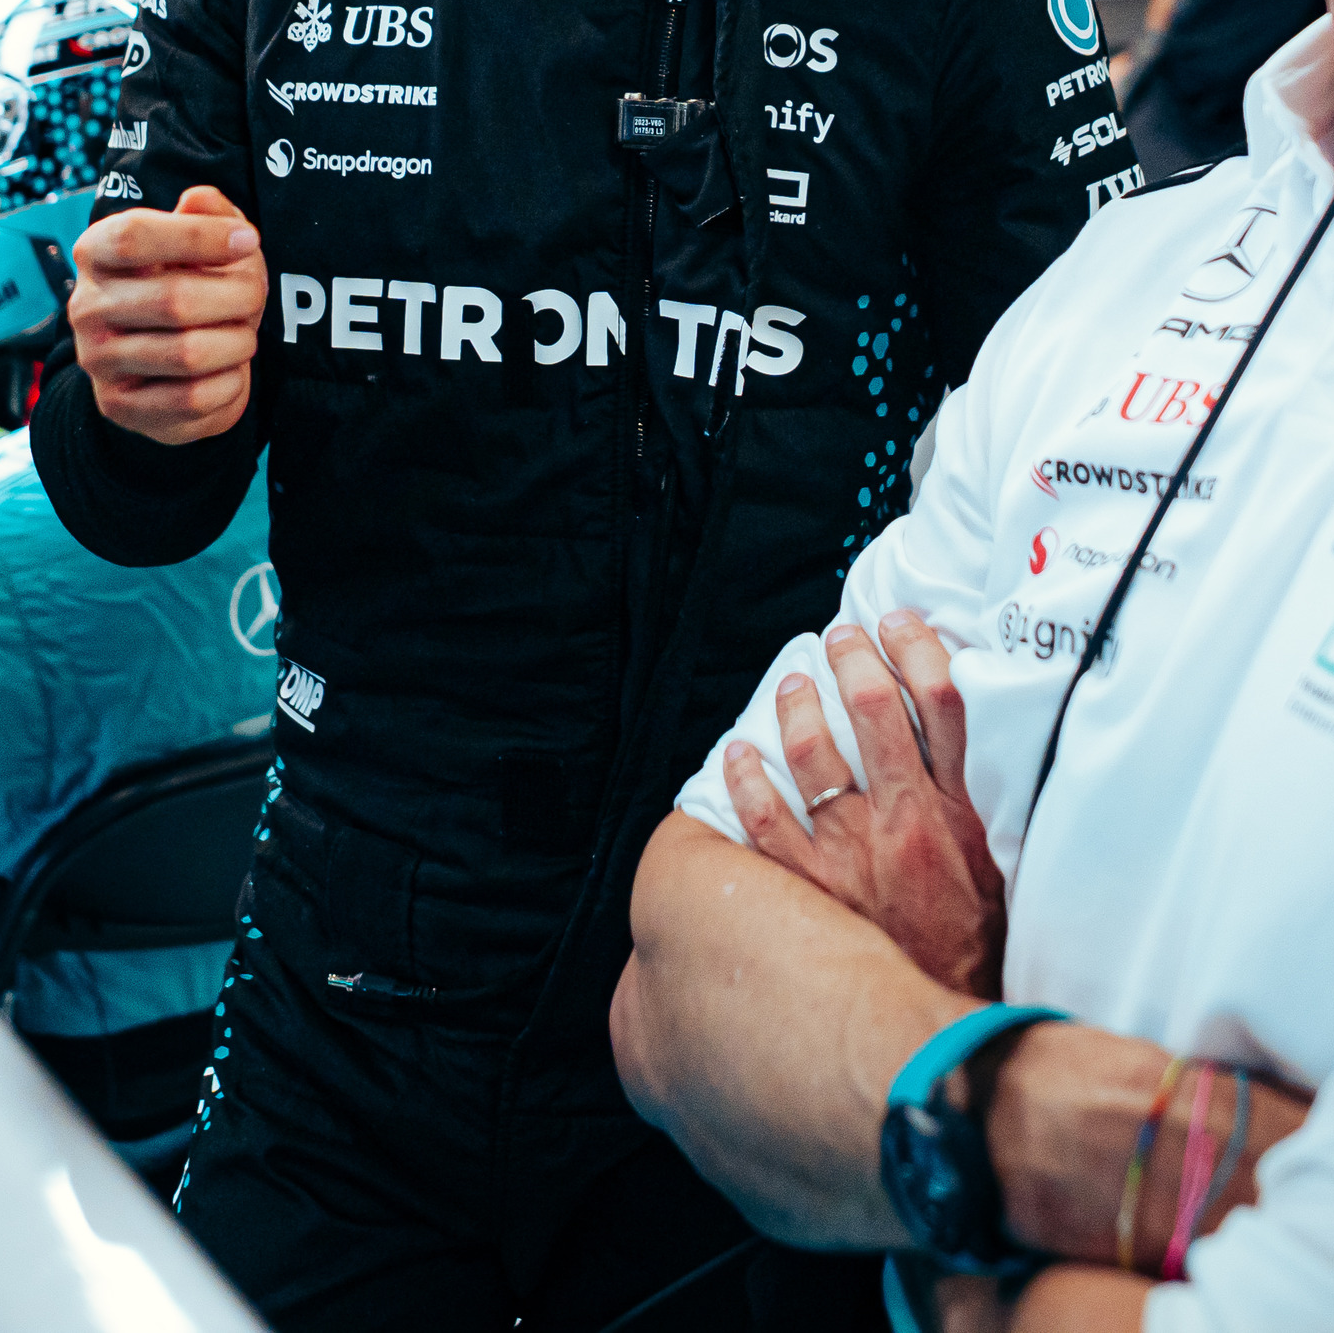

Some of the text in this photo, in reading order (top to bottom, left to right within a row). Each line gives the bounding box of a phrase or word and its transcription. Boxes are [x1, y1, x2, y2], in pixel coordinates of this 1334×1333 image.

[342, 5, 434, 48] UBS
[281, 82, 438, 106] CROWDSTRIKE
[303, 147, 432, 179] Snapdragon
[280, 664, 324, 717] OMP
